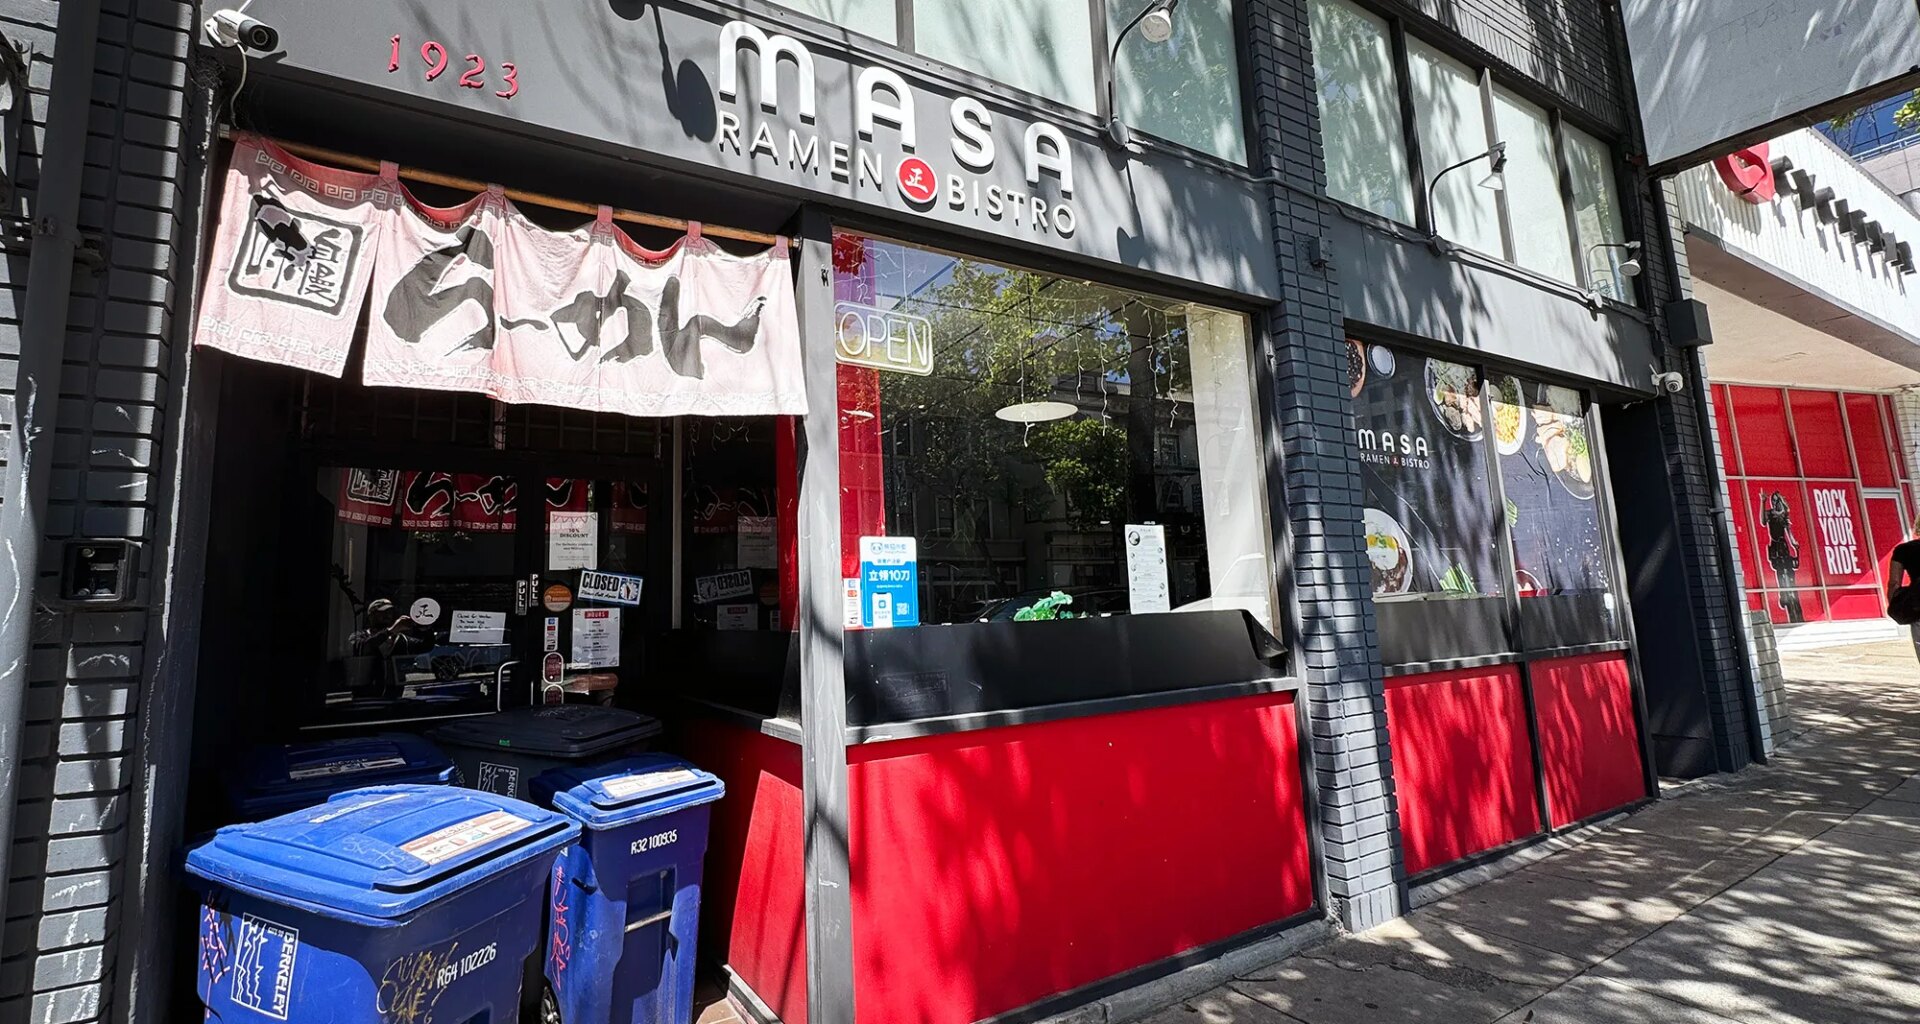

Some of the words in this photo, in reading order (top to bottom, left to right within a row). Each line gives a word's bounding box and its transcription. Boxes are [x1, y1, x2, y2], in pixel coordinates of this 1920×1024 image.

[387, 34, 520, 99] 1923
[718, 20, 1075, 195] MASA
[718, 110, 884, 189] RAMEN
[946, 173, 1077, 236] BISTRO
[384, 227, 768, 379] らーめん
[839, 310, 928, 367] OPEN
[1357, 428, 1429, 457] MASA
[1360, 452, 1391, 465] RAMEN
[1400, 457, 1430, 470] BISTRO
[1813, 488, 1851, 517] ROCK
[1818, 517, 1857, 546] YOUR
[1824, 546, 1861, 575] RIDE
[518, 581, 526, 607] PULL
[582, 573, 620, 592] CLOSED
[630, 837, 648, 855] R32
[272, 931, 295, 1015] BERKELEY
[436, 961, 458, 989] R64
[459, 942, 498, 977] 102226
